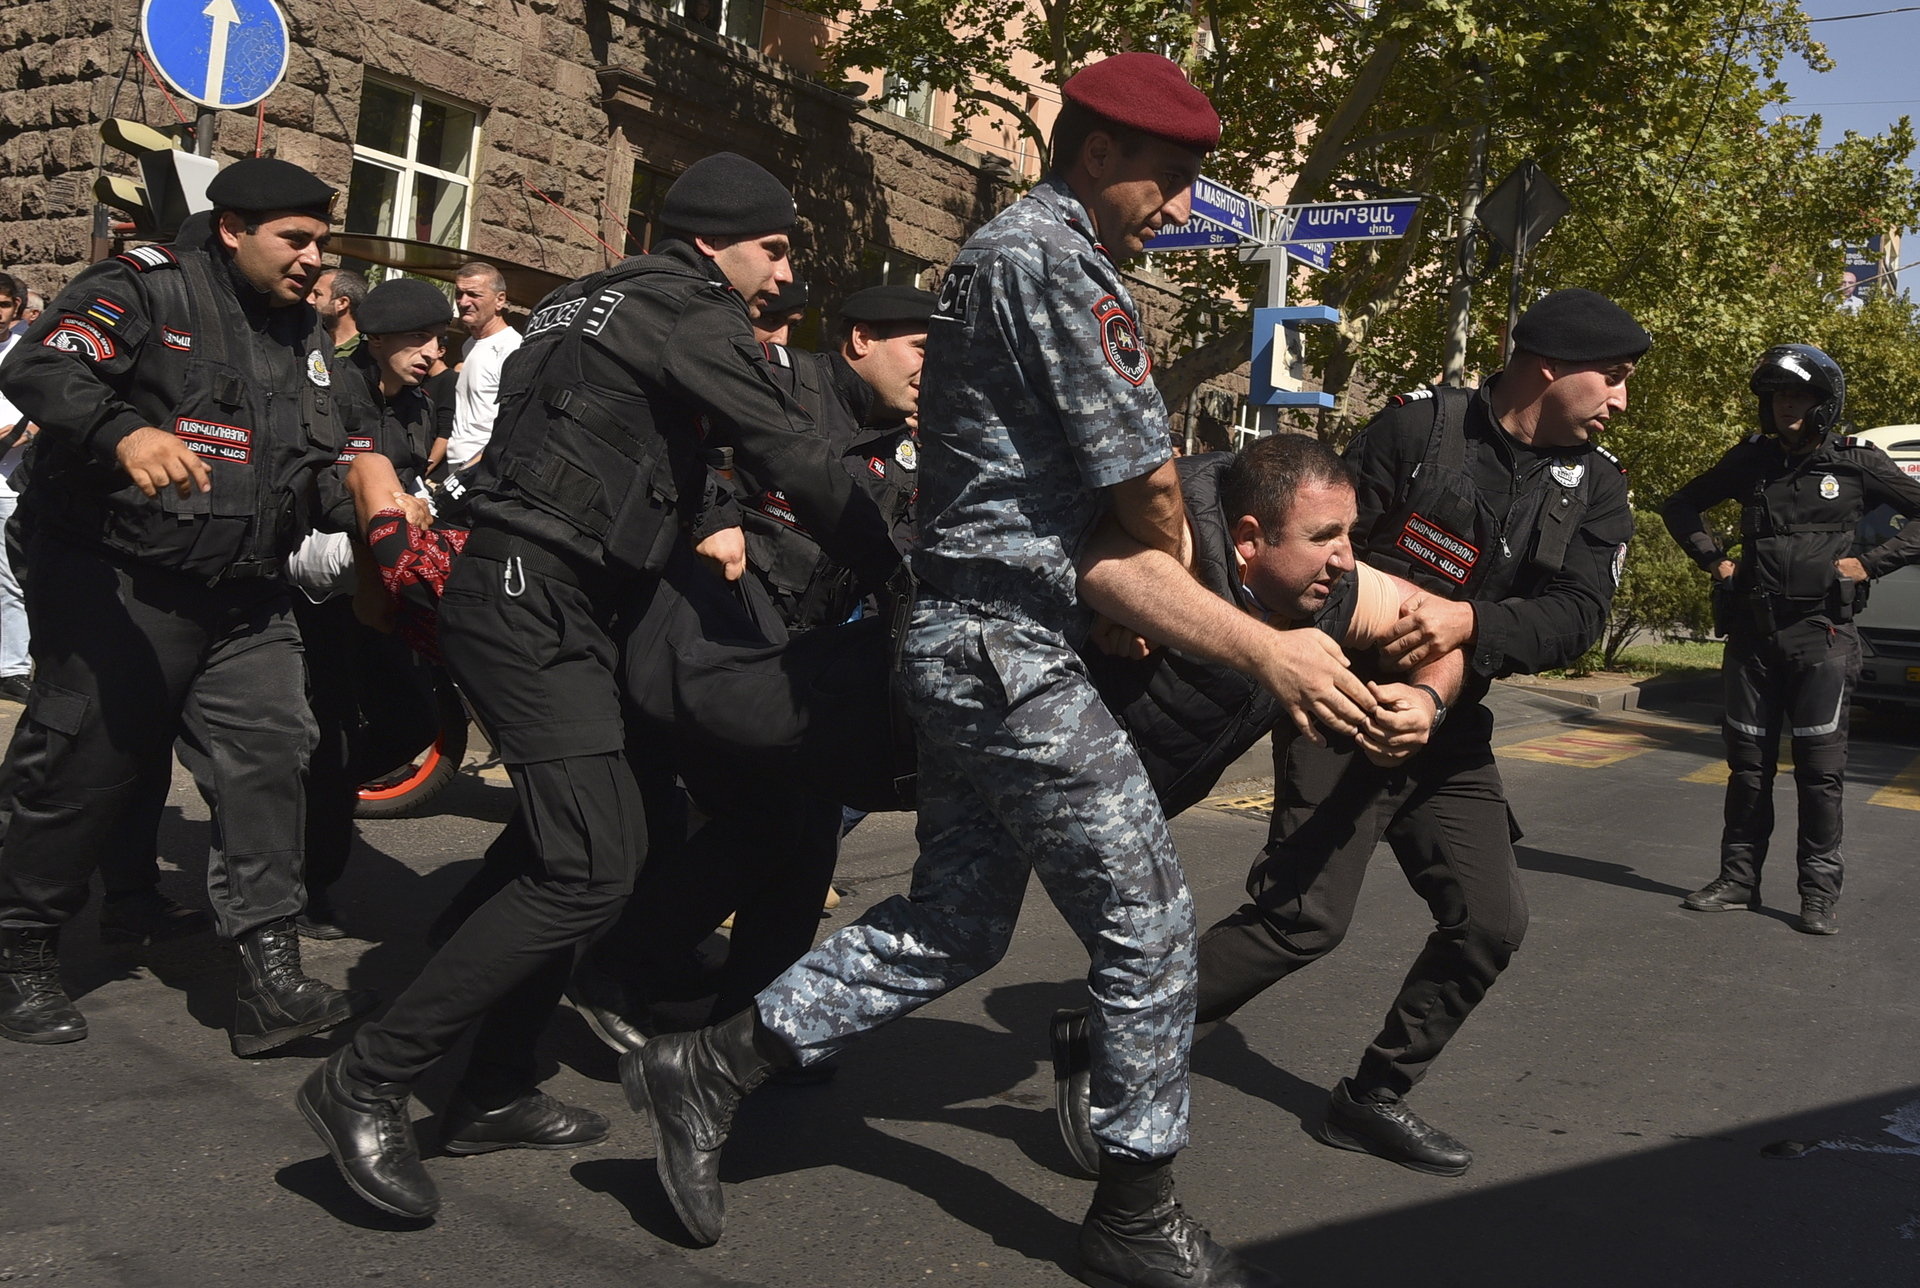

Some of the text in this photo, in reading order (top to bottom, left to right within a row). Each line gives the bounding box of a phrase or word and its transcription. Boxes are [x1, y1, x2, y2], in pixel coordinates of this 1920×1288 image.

[1195, 180, 1246, 219] M.MASHTOTS
[1231, 216, 1244, 230] Ave.
[1308, 206, 1395, 226] ԱՄԻՐՅԱՆ
[1209, 233, 1226, 243] Str.
[1369, 223, 1395, 236] փող.
[1403, 535, 1465, 579] ՀԱՏՈՒԿ ՎԱՇՏ
